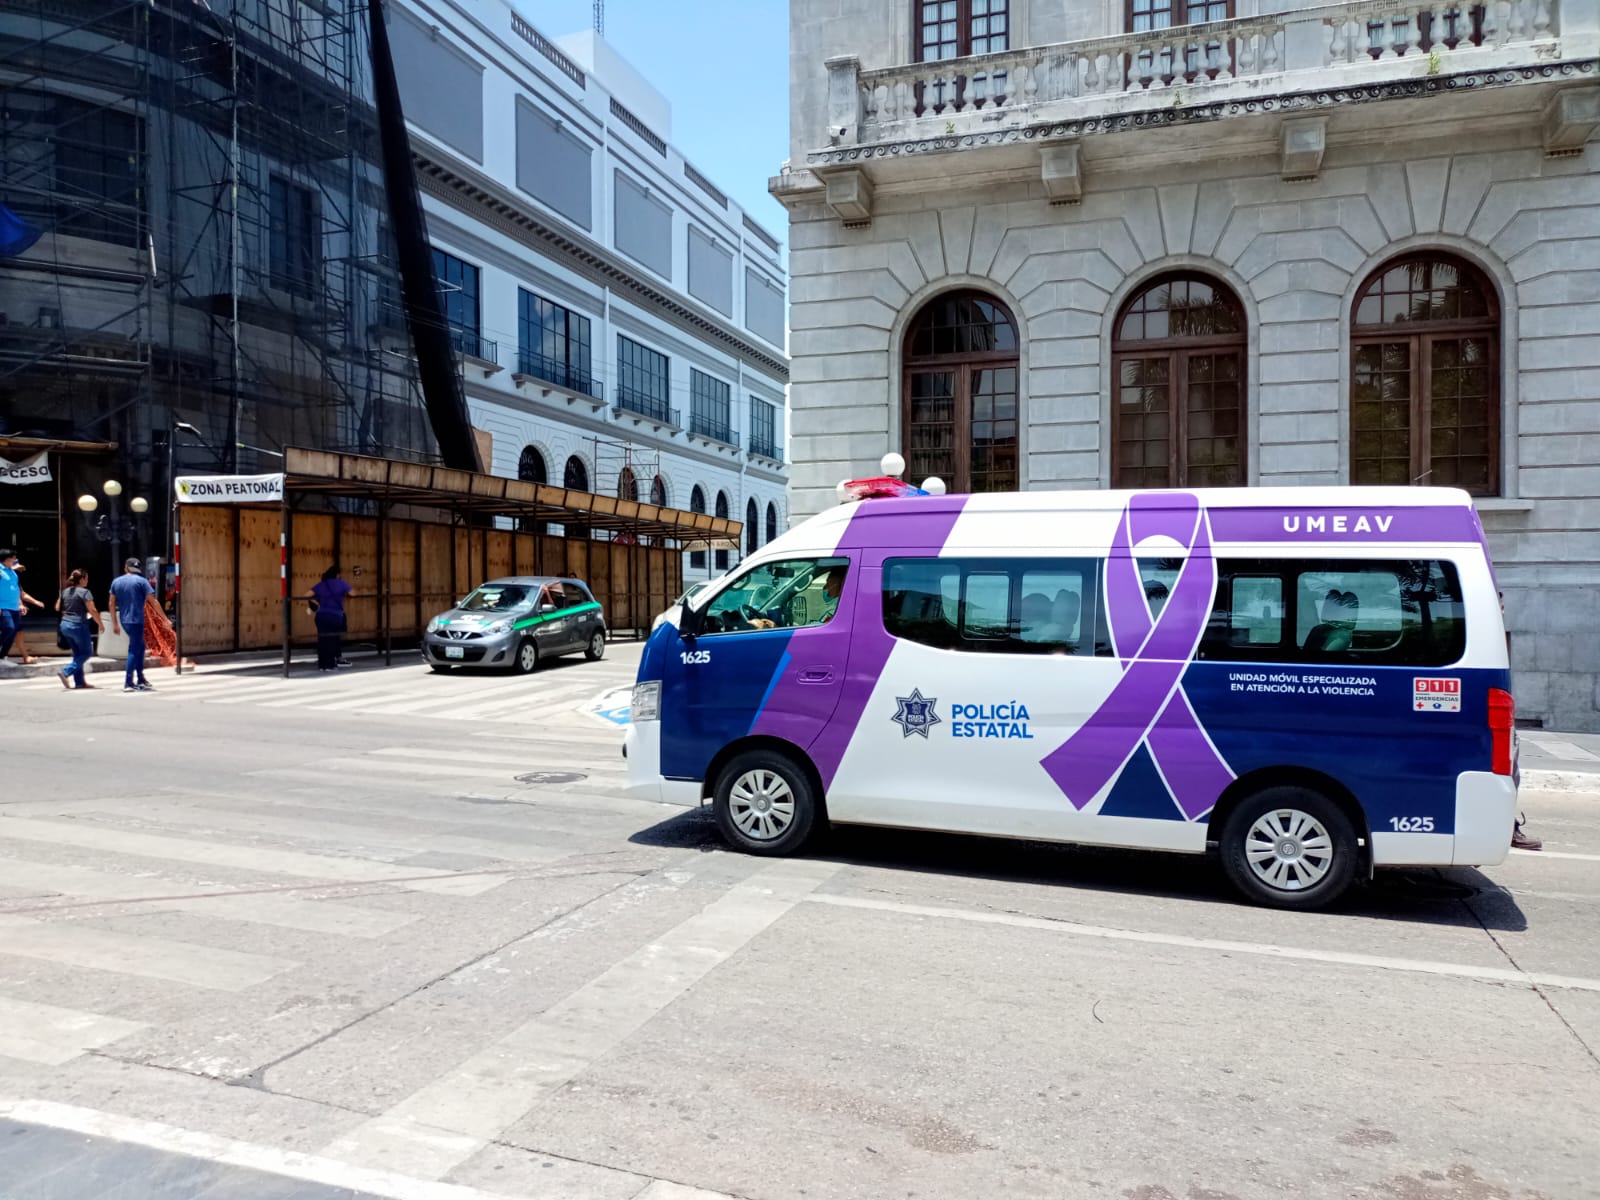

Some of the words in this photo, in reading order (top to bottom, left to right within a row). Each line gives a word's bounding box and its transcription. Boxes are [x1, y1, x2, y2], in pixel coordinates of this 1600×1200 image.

[190, 483, 223, 495] ZONA
[225, 482, 281, 494] PEATONAL
[1283, 515, 1393, 533] UMEAV
[680, 651, 711, 664] 1625
[1229, 673, 1267, 682] UNIDAD
[1269, 672, 1300, 683] MÓVIL
[1302, 675, 1377, 686] ESPECIALIZADA
[1417, 681, 1455, 691] 911
[1230, 683, 1244, 691] EN
[1246, 684, 1296, 693] ATENCIÓN
[1297, 686, 1306, 694] A
[1307, 686, 1320, 694] LA
[1322, 686, 1375, 696] VIOLENCIA
[952, 700, 1030, 720] POLICÍA
[952, 722, 1034, 739] ESTATAL
[1389, 816, 1435, 832] 1625
